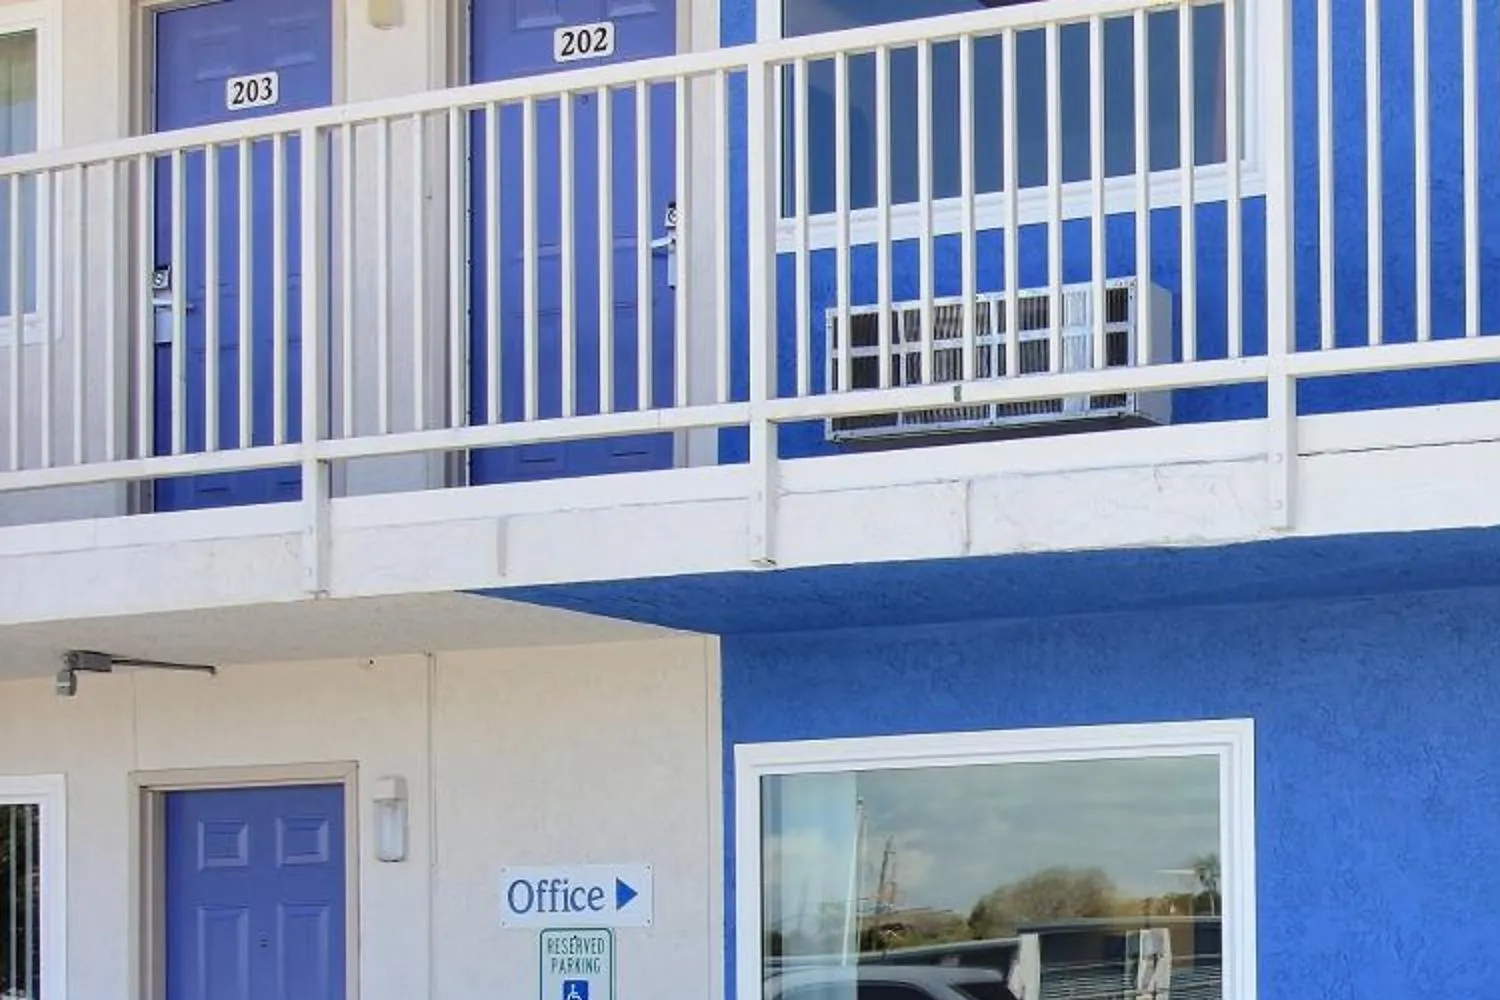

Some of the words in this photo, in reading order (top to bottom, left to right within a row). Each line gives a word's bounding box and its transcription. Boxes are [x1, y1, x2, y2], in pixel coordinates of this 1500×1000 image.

[560, 27, 608, 57] 202
[232, 77, 273, 105] 203
[507, 878, 605, 914] Office
[547, 937, 605, 955] RESERVED
[551, 958, 601, 974] PARKING
